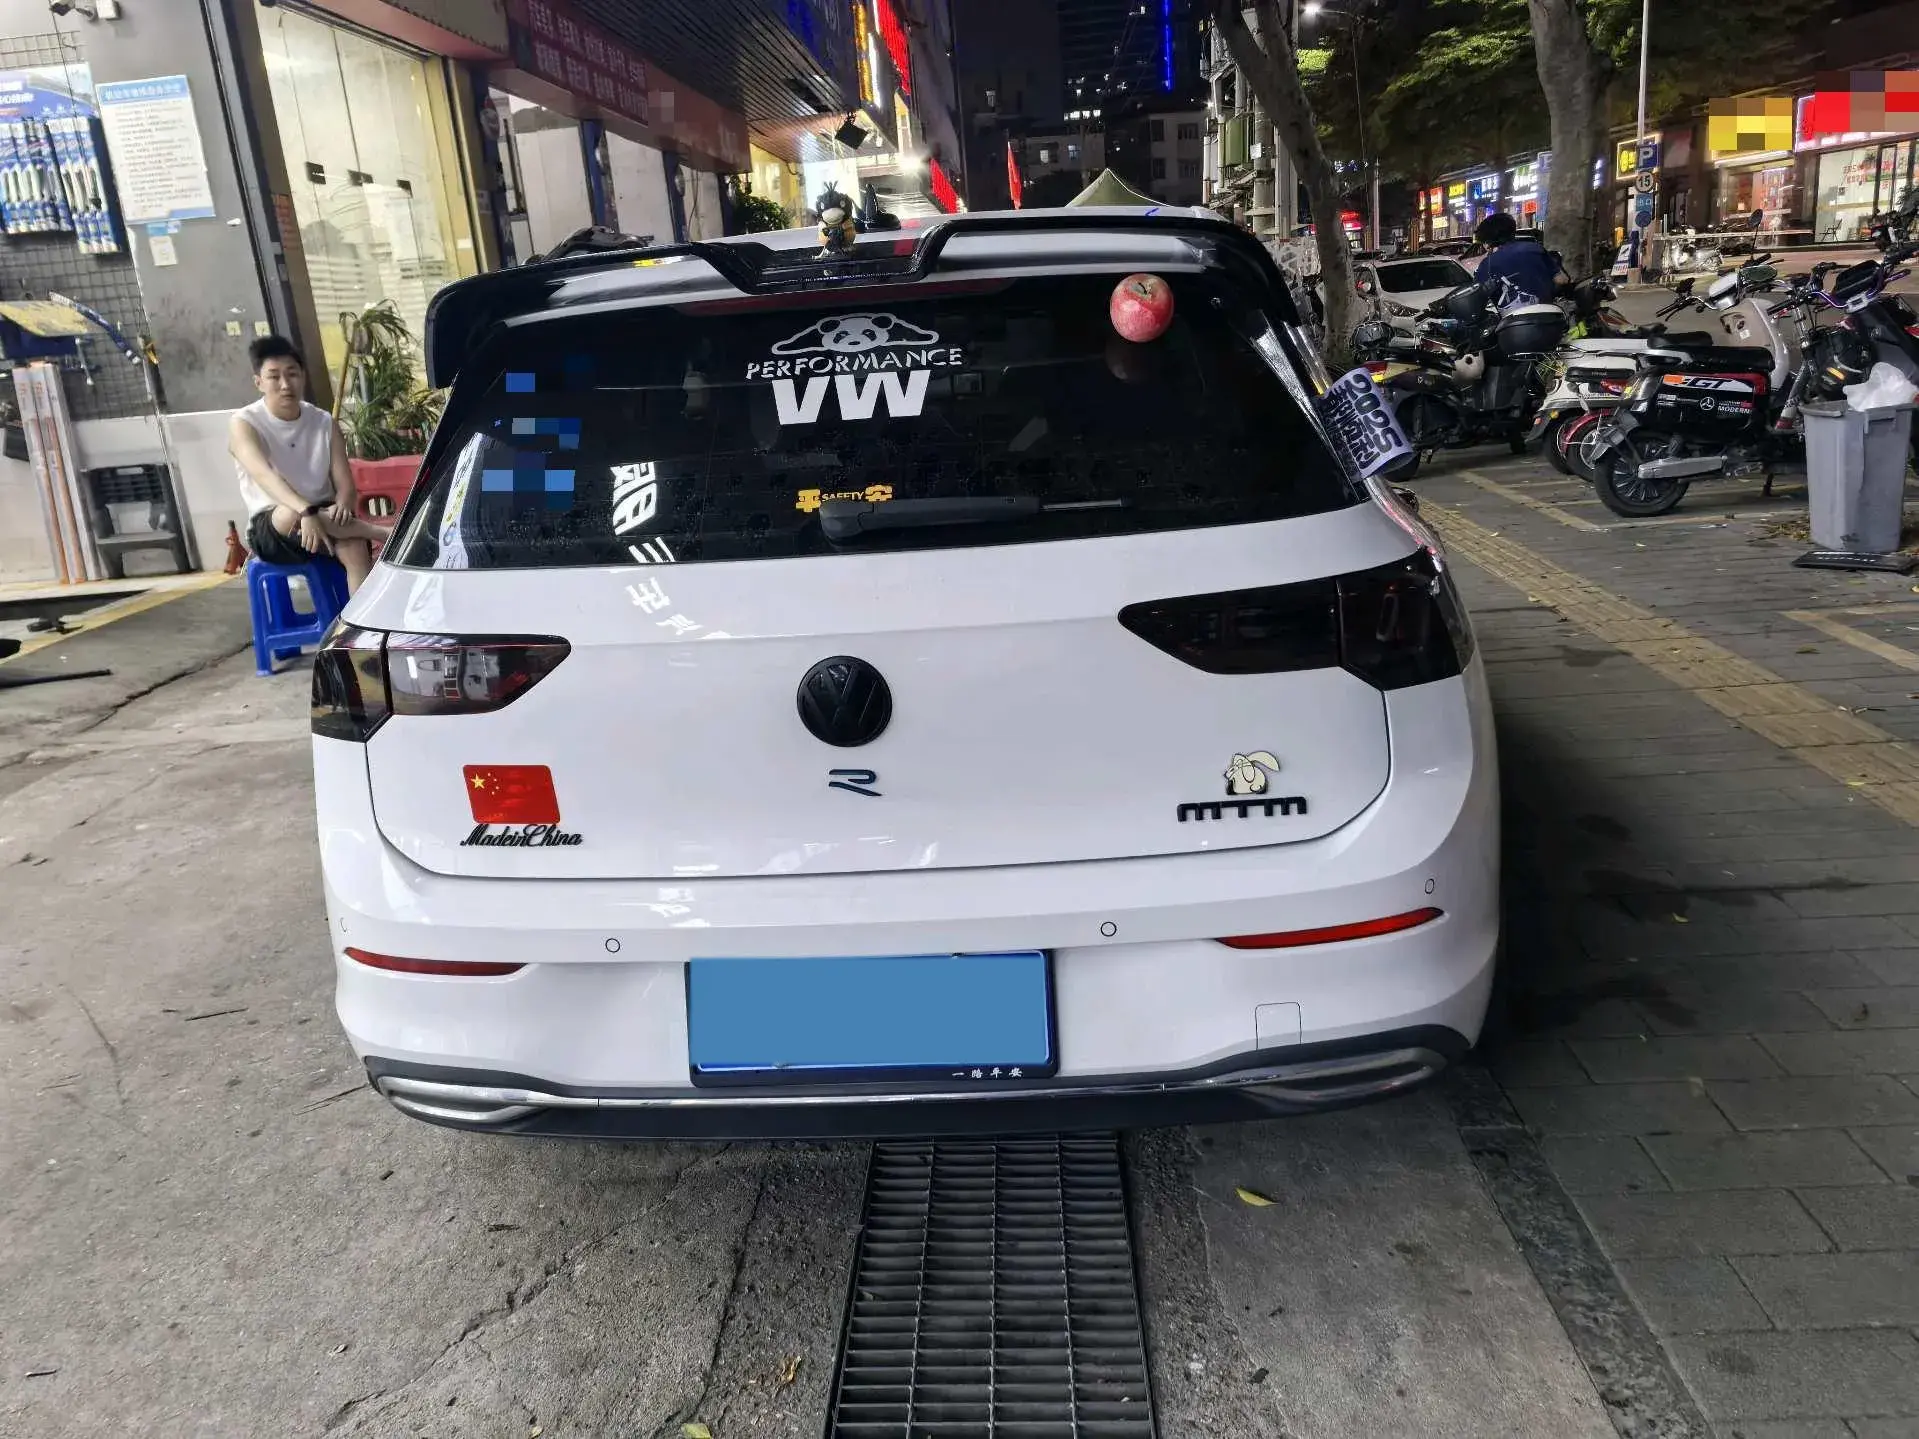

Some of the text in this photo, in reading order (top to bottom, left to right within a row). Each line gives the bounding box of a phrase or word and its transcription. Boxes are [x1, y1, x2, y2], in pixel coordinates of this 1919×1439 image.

[1639, 147, 1654, 167] P
[1638, 175, 1651, 188] 15
[745, 347, 963, 380] PERFORMANCE
[771, 369, 931, 425] VW
[1343, 373, 1404, 454] 2025
[821, 491, 865, 502] SAFETY
[828, 768, 883, 797] R
